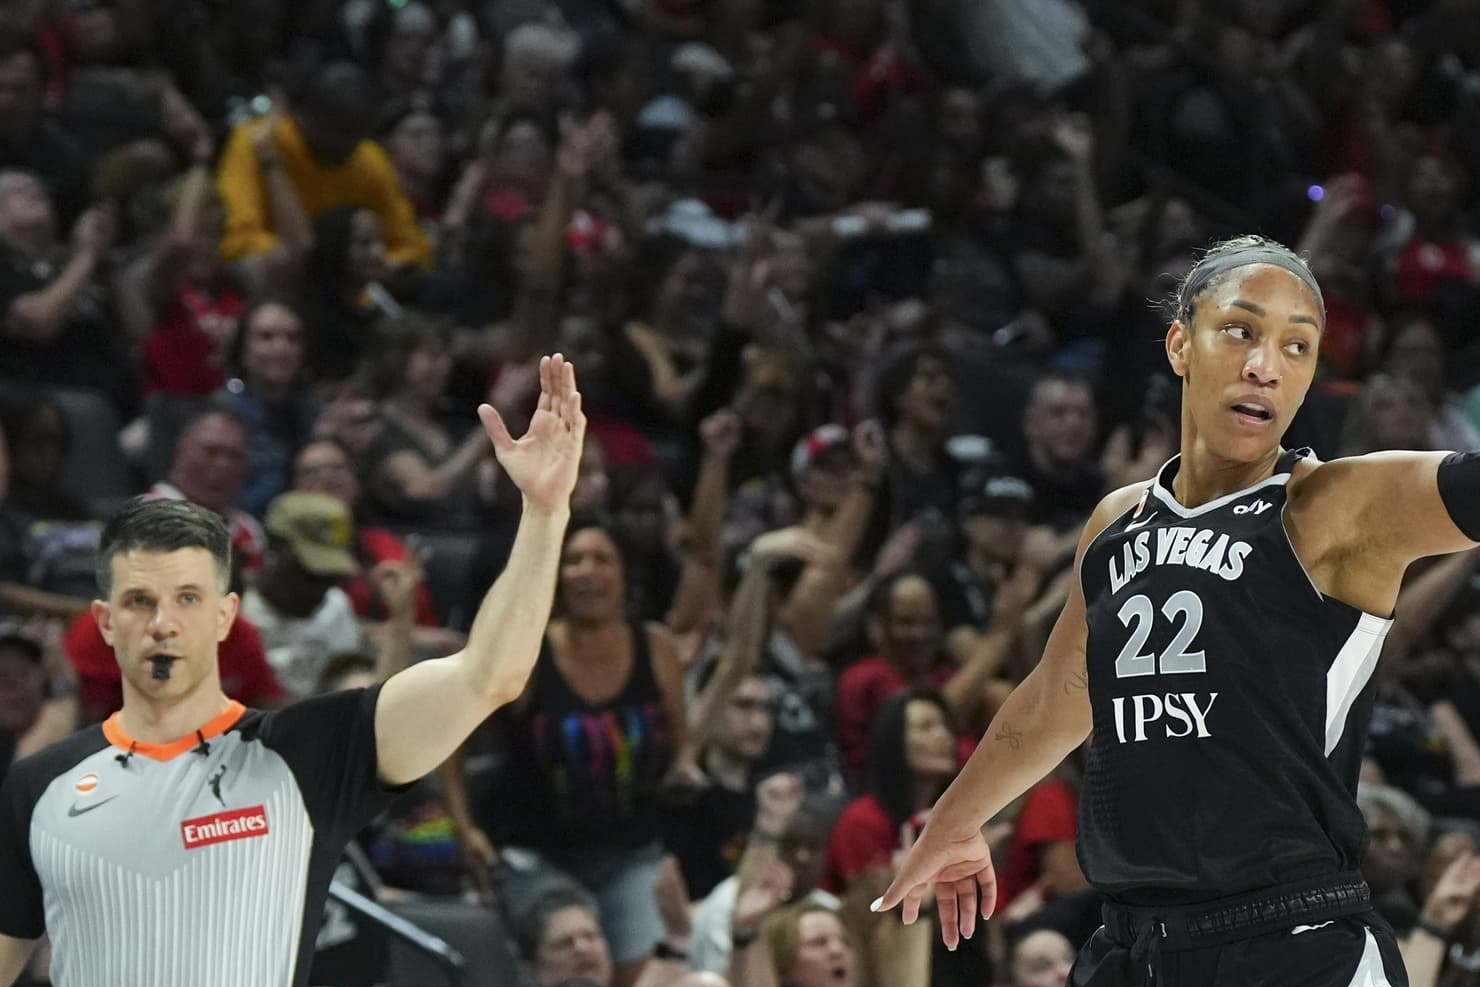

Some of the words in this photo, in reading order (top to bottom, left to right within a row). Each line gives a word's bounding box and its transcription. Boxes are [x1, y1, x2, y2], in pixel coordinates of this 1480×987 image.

[1108, 531, 1151, 595] LAS
[1155, 527, 1253, 581] VEGAS
[1115, 590, 1207, 678] 22
[1112, 692, 1218, 743] IPSY
[183, 814, 266, 843] Emirates
